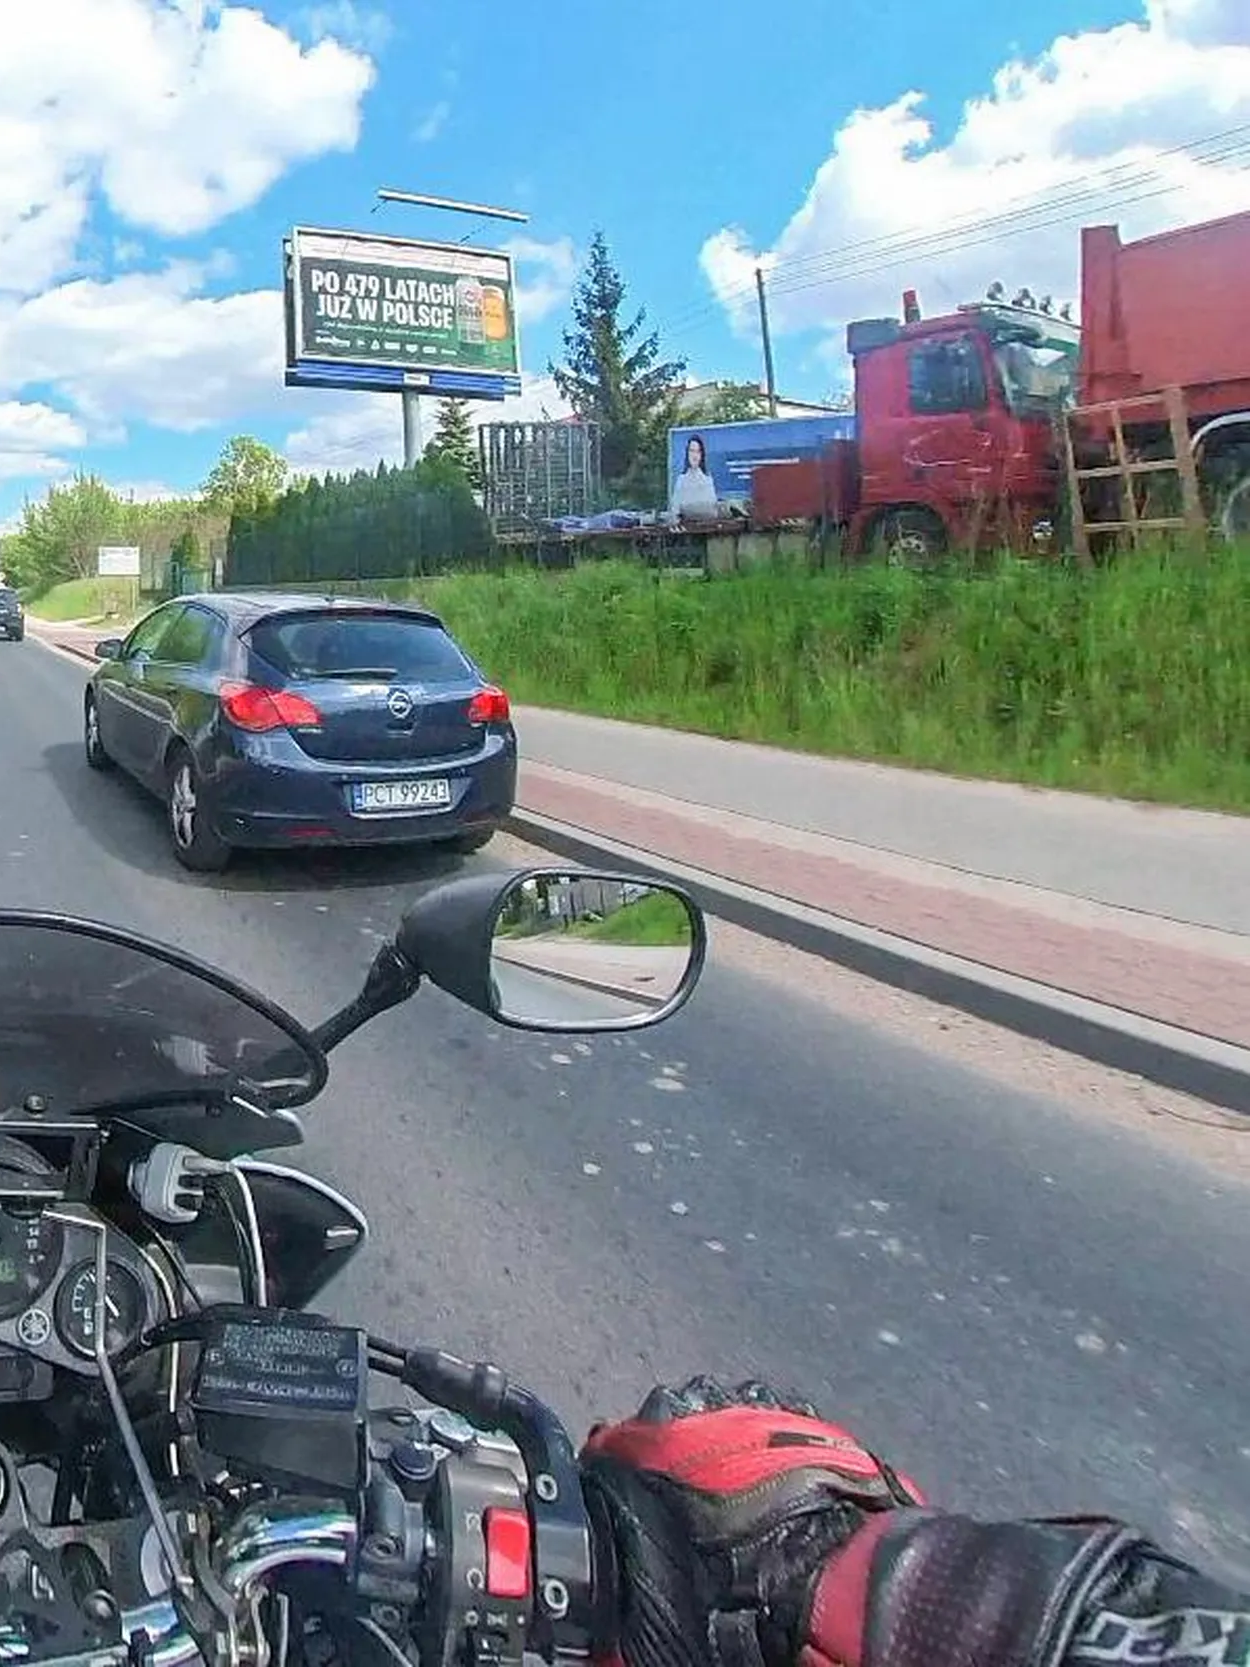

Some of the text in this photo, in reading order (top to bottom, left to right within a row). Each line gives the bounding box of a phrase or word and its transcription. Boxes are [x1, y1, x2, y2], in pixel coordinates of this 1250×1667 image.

[312, 269, 455, 307] PO 479 LATACH
[356, 298, 377, 321] W
[383, 300, 454, 329] POLSCE
[364, 780, 447, 803] PCT 99243
